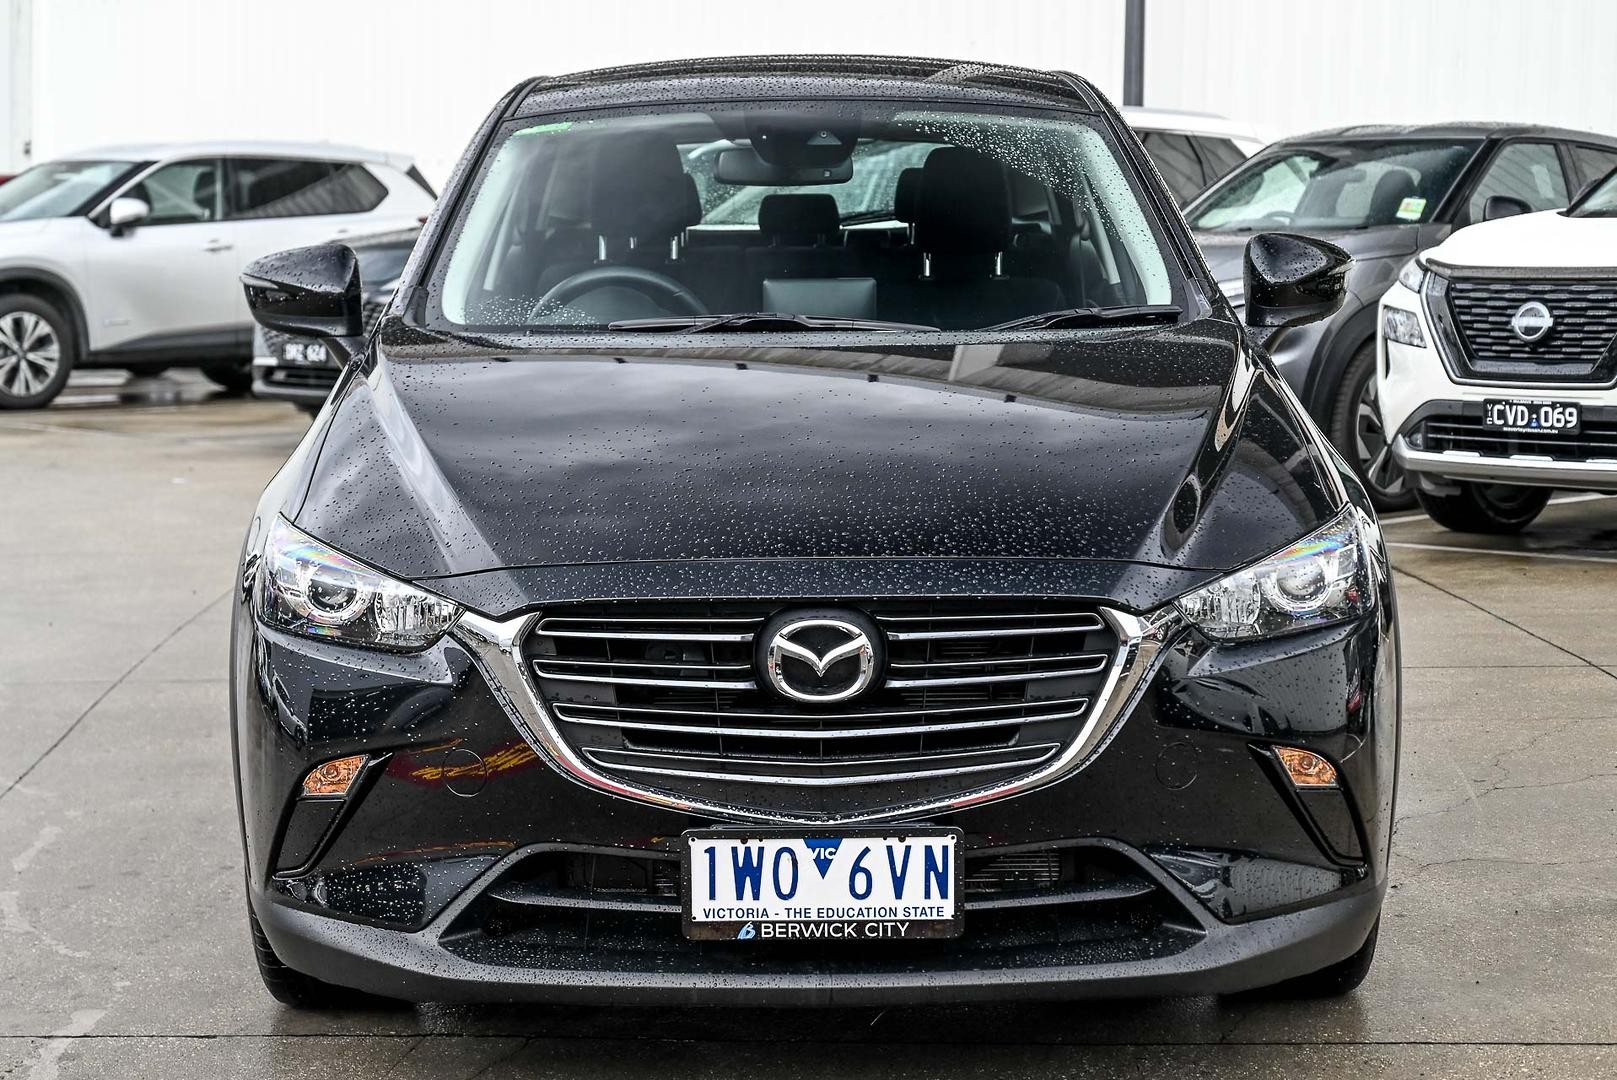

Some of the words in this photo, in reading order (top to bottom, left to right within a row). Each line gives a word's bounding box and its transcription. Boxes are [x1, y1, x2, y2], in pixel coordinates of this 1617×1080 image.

[1492, 404, 1529, 426] CVD
[1540, 406, 1578, 428] 069
[808, 847, 837, 860] VIC
[848, 845, 949, 900] 6VN
[703, 907, 770, 919] VICTORIA
[784, 907, 812, 919] THE
[816, 906, 898, 919] EDUCATION
[902, 906, 945, 918] STATE
[760, 922, 858, 938] BERWICK
[864, 921, 910, 938] CITY
